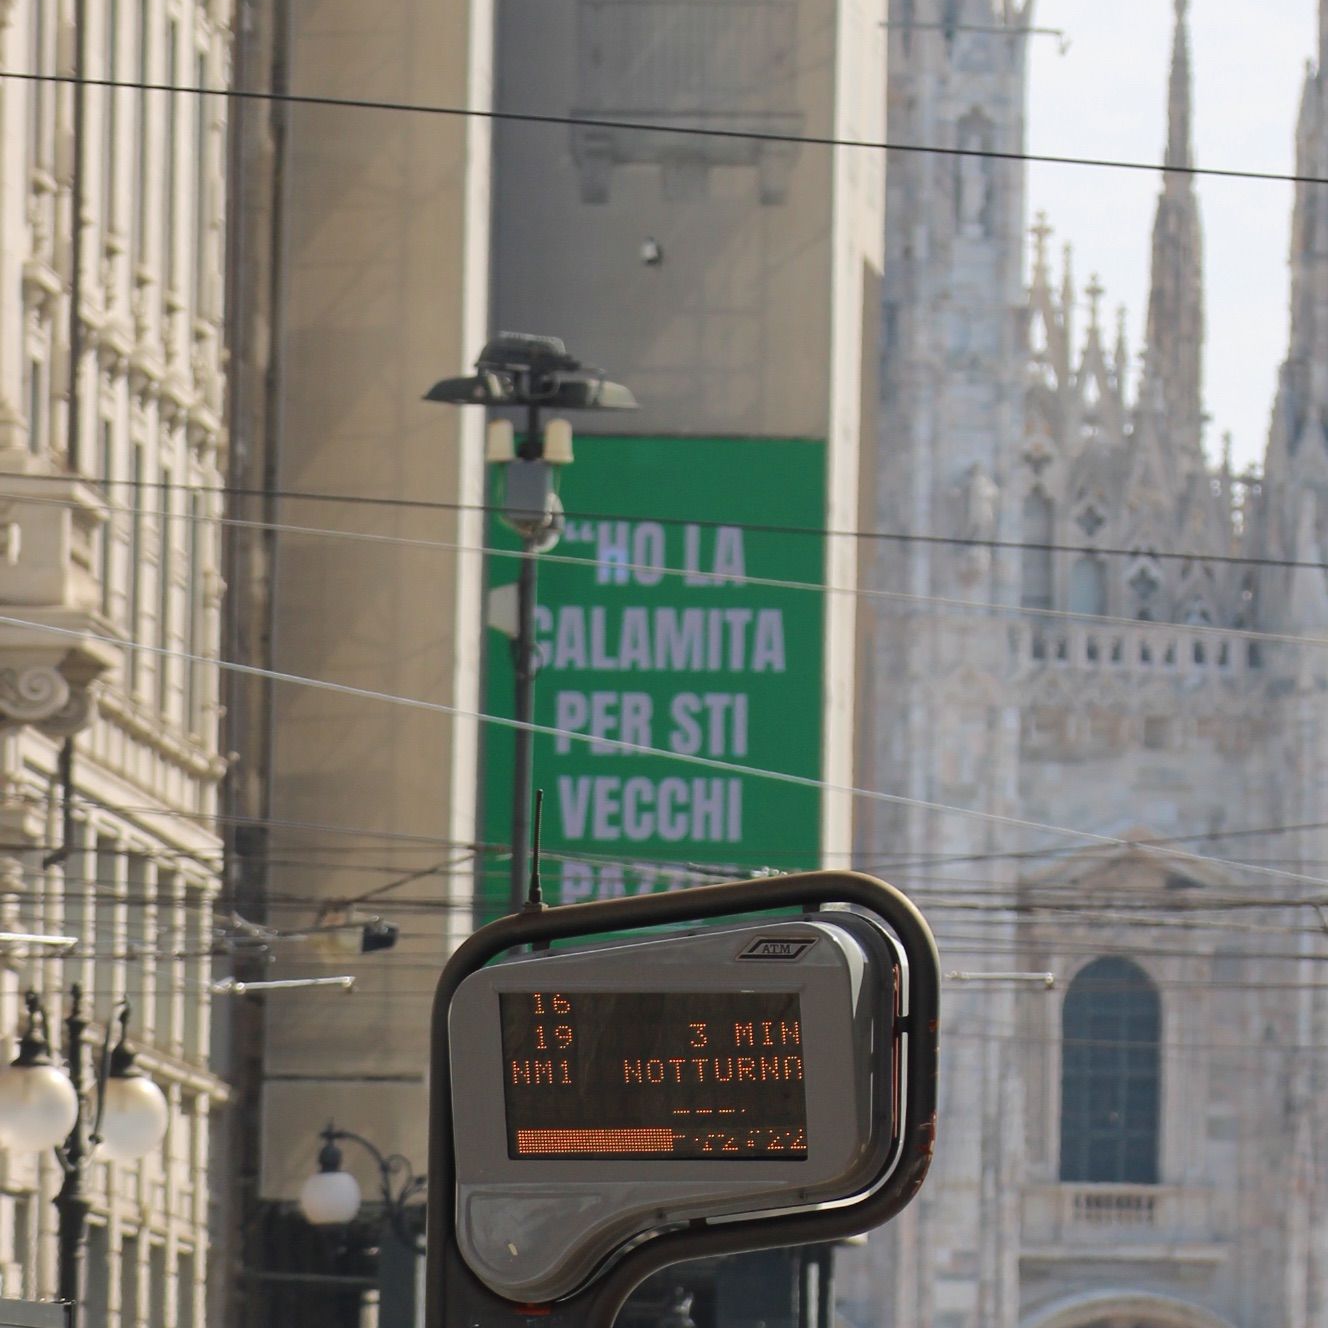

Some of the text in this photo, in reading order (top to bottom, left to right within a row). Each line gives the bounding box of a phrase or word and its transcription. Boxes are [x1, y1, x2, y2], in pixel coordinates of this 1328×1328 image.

[682, 524, 747, 587] LA
[555, 690, 748, 757] PER STI
[557, 774, 743, 843] VECCHI
[761, 943, 793, 955] ATM
[533, 993, 572, 1014] 16
[535, 1021, 802, 1050] 19 3 MIN
[511, 1058, 573, 1085] NM1
